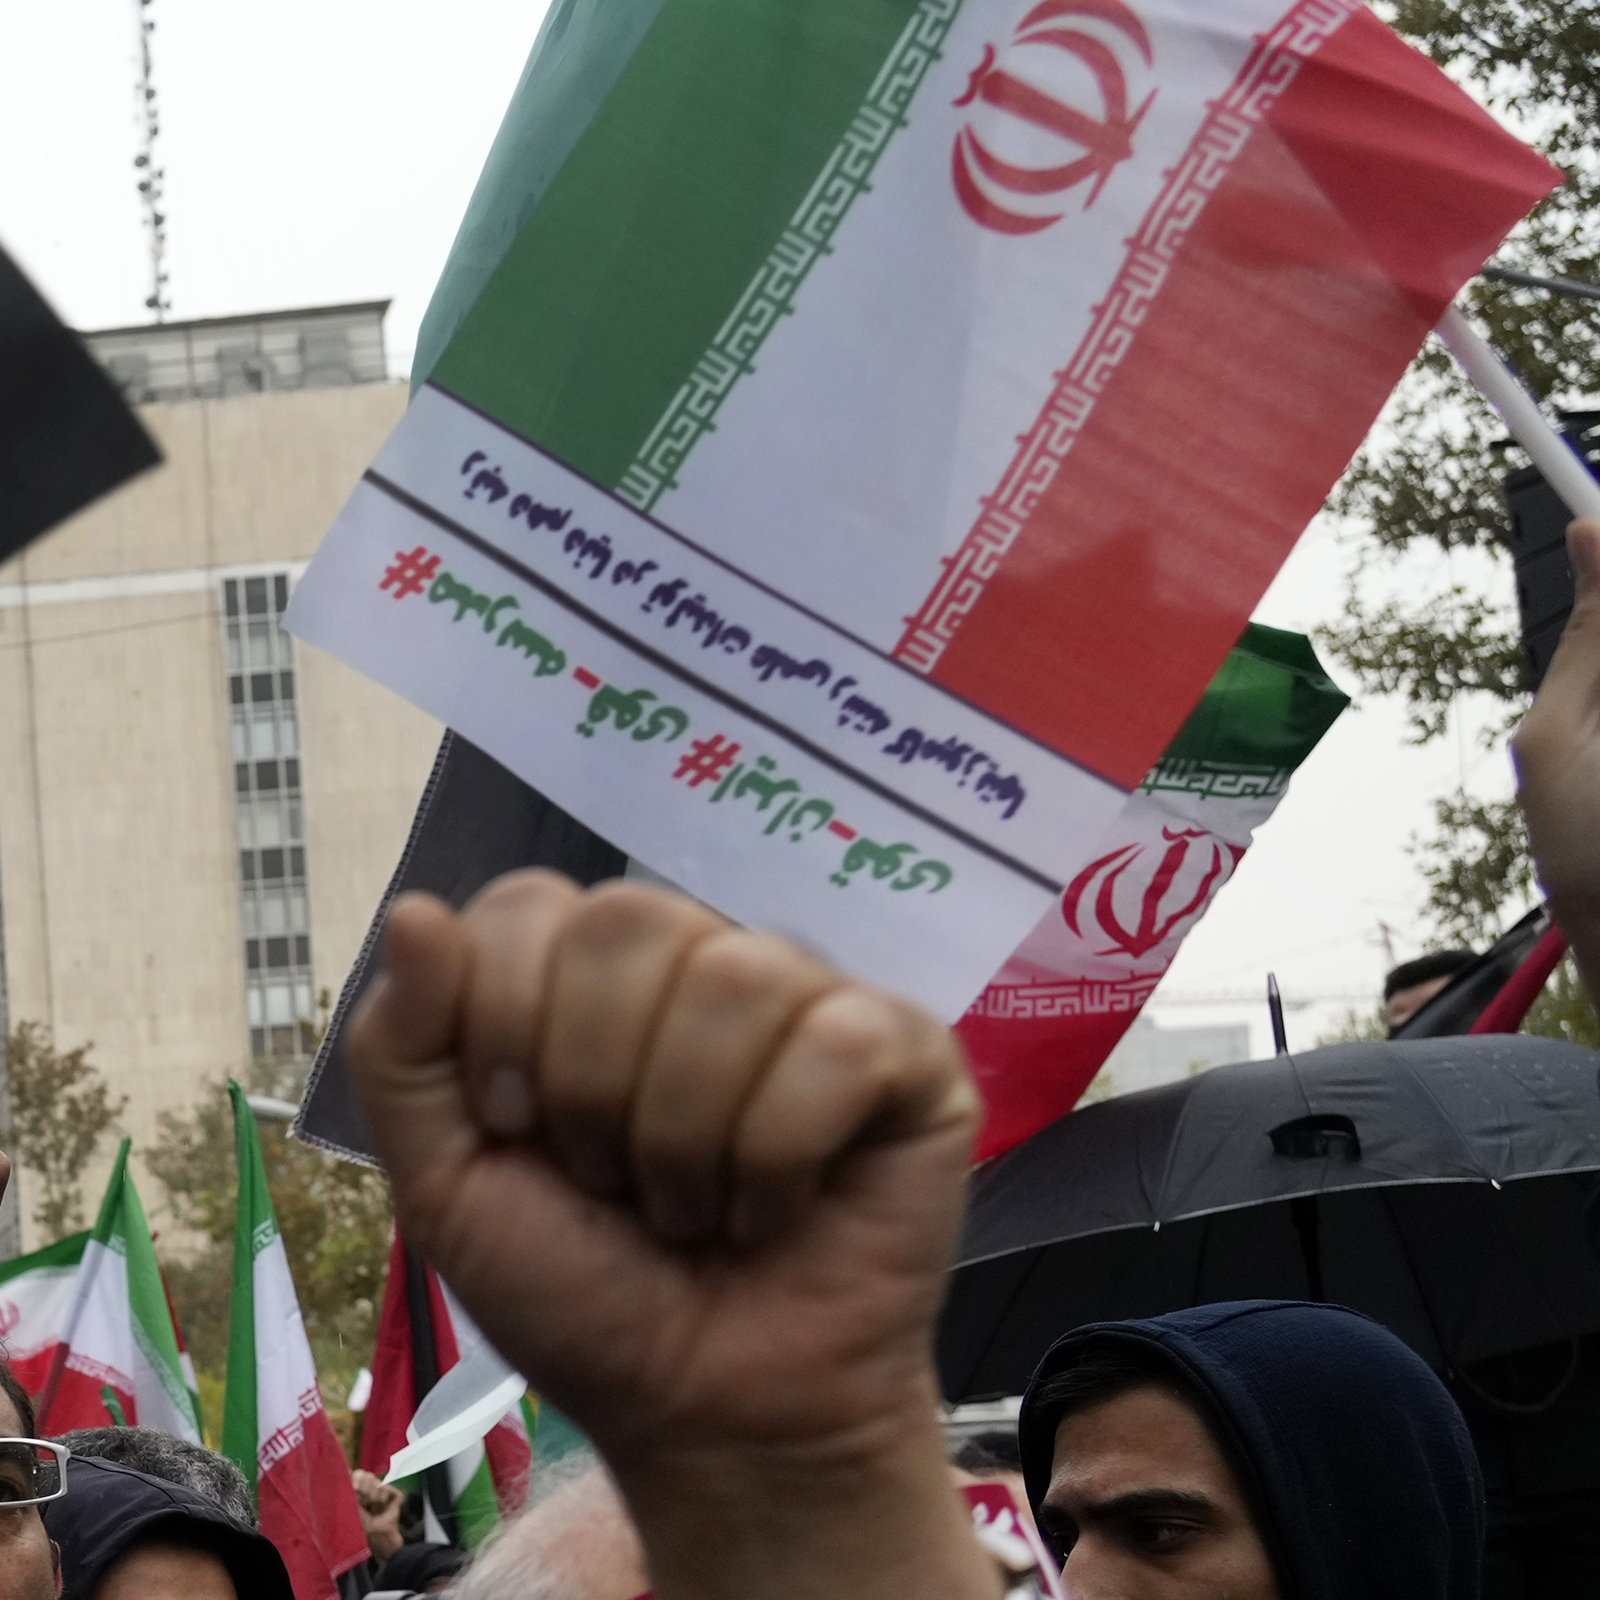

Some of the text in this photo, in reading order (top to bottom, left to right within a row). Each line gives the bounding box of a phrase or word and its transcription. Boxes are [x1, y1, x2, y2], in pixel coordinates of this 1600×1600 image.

[461, 450, 509, 503] رتبه
[509, 493, 573, 531] دهم
[563, 528, 612, 580] دنیا
[611, 561, 659, 586] در
[640, 578, 751, 654] تولیدات
